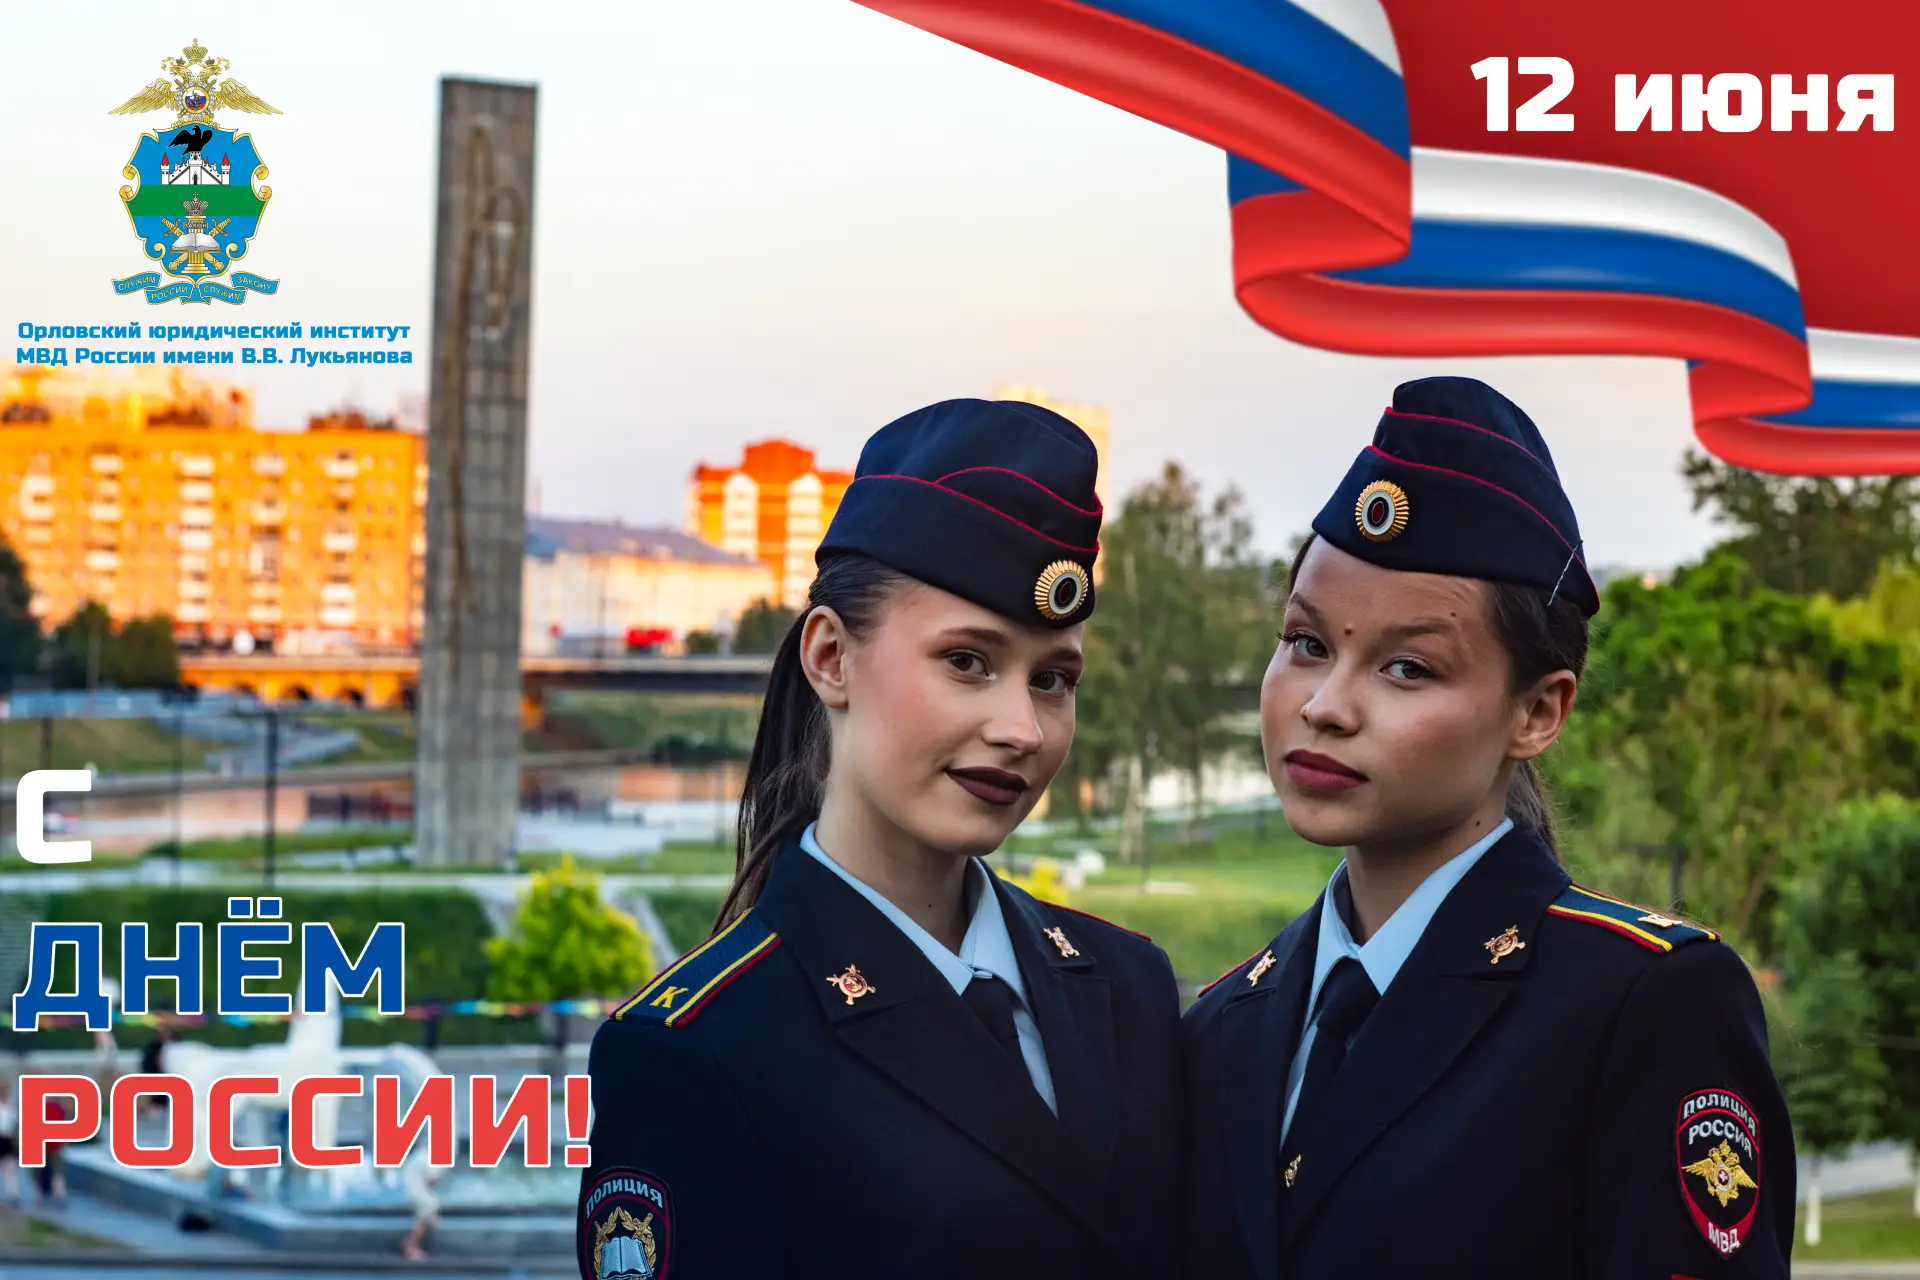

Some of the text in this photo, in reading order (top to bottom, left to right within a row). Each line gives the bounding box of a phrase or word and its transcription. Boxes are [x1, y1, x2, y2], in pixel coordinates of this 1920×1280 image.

[650, 986, 689, 1008] К
[1683, 1093, 1757, 1138] ПОЛИЦИЯ
[1688, 1119, 1753, 1161] РОССИЯ
[586, 1178, 664, 1219] ПОЛИЦИЯ
[1708, 1221, 1741, 1253] МВД
